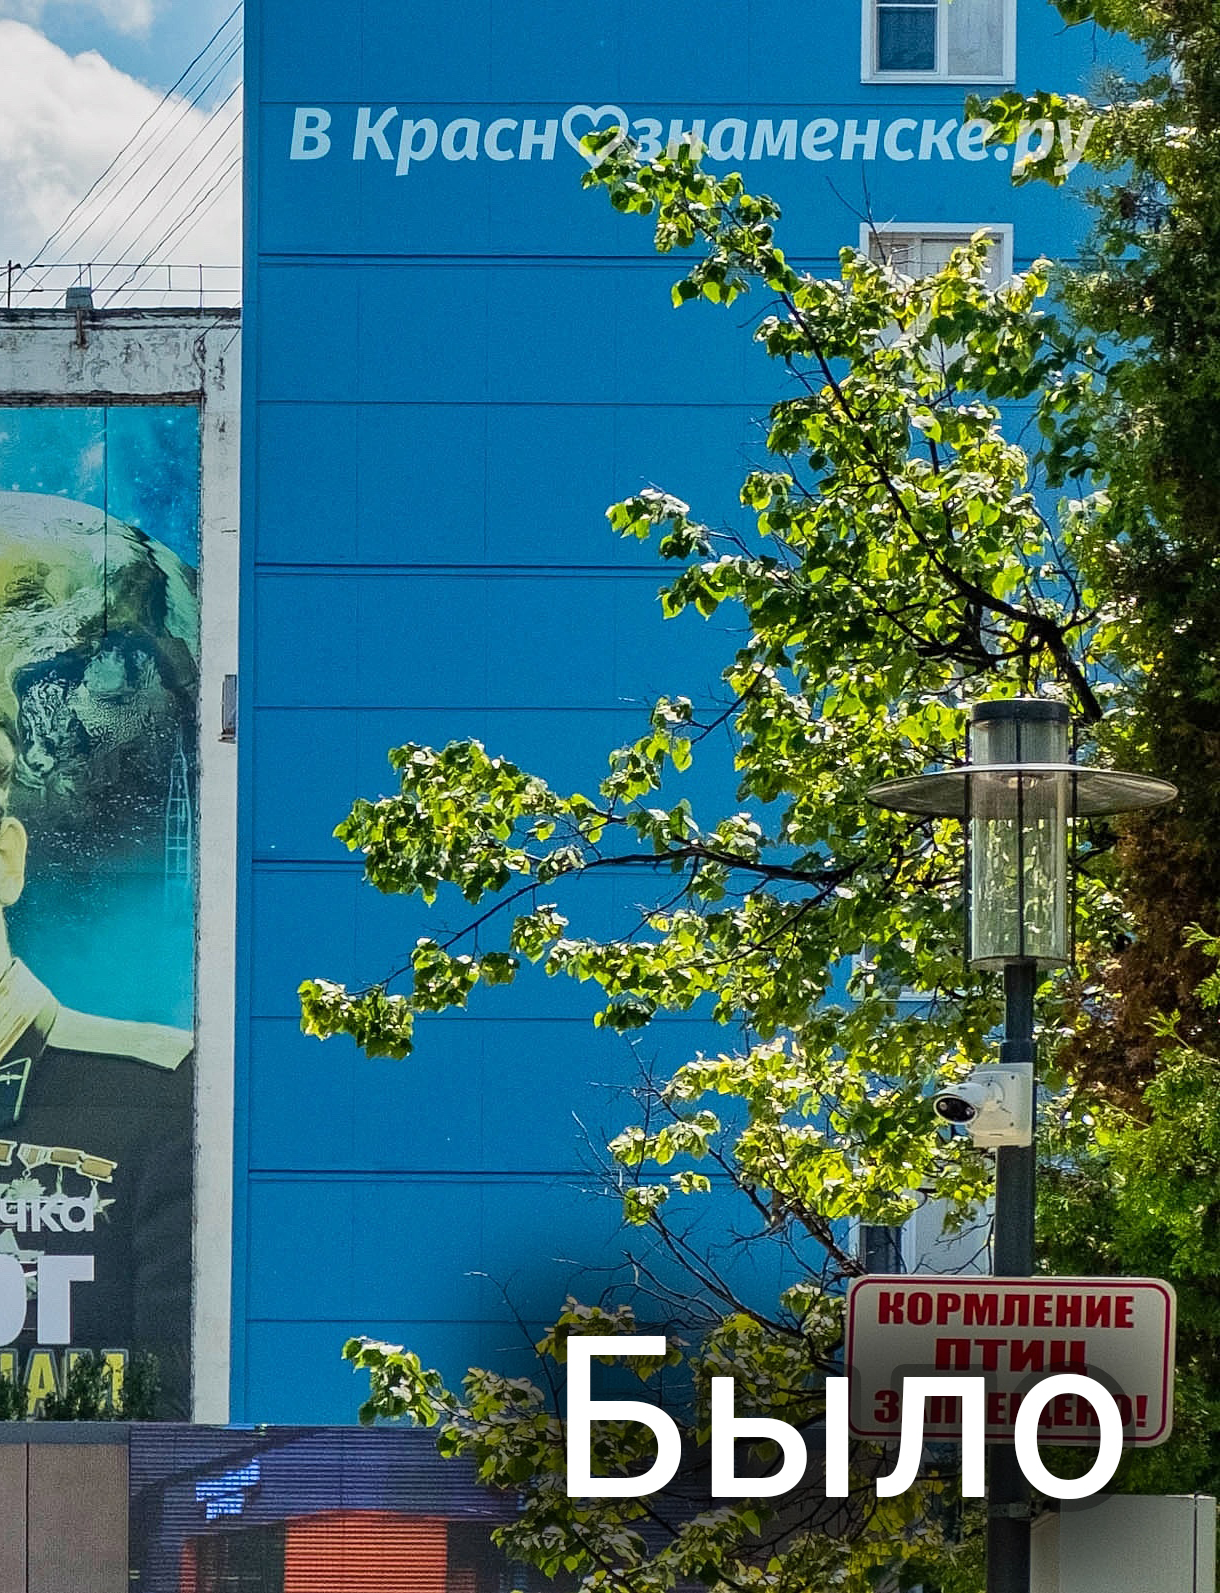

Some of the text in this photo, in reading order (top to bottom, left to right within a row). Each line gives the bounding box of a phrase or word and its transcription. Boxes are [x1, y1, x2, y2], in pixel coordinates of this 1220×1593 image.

[877, 1291, 1135, 1329] КОРМЛЕНИЕ
[934, 1338, 1088, 1376] ПТИЦ
[873, 1389, 1149, 1429] ЗПЕЕНО!
